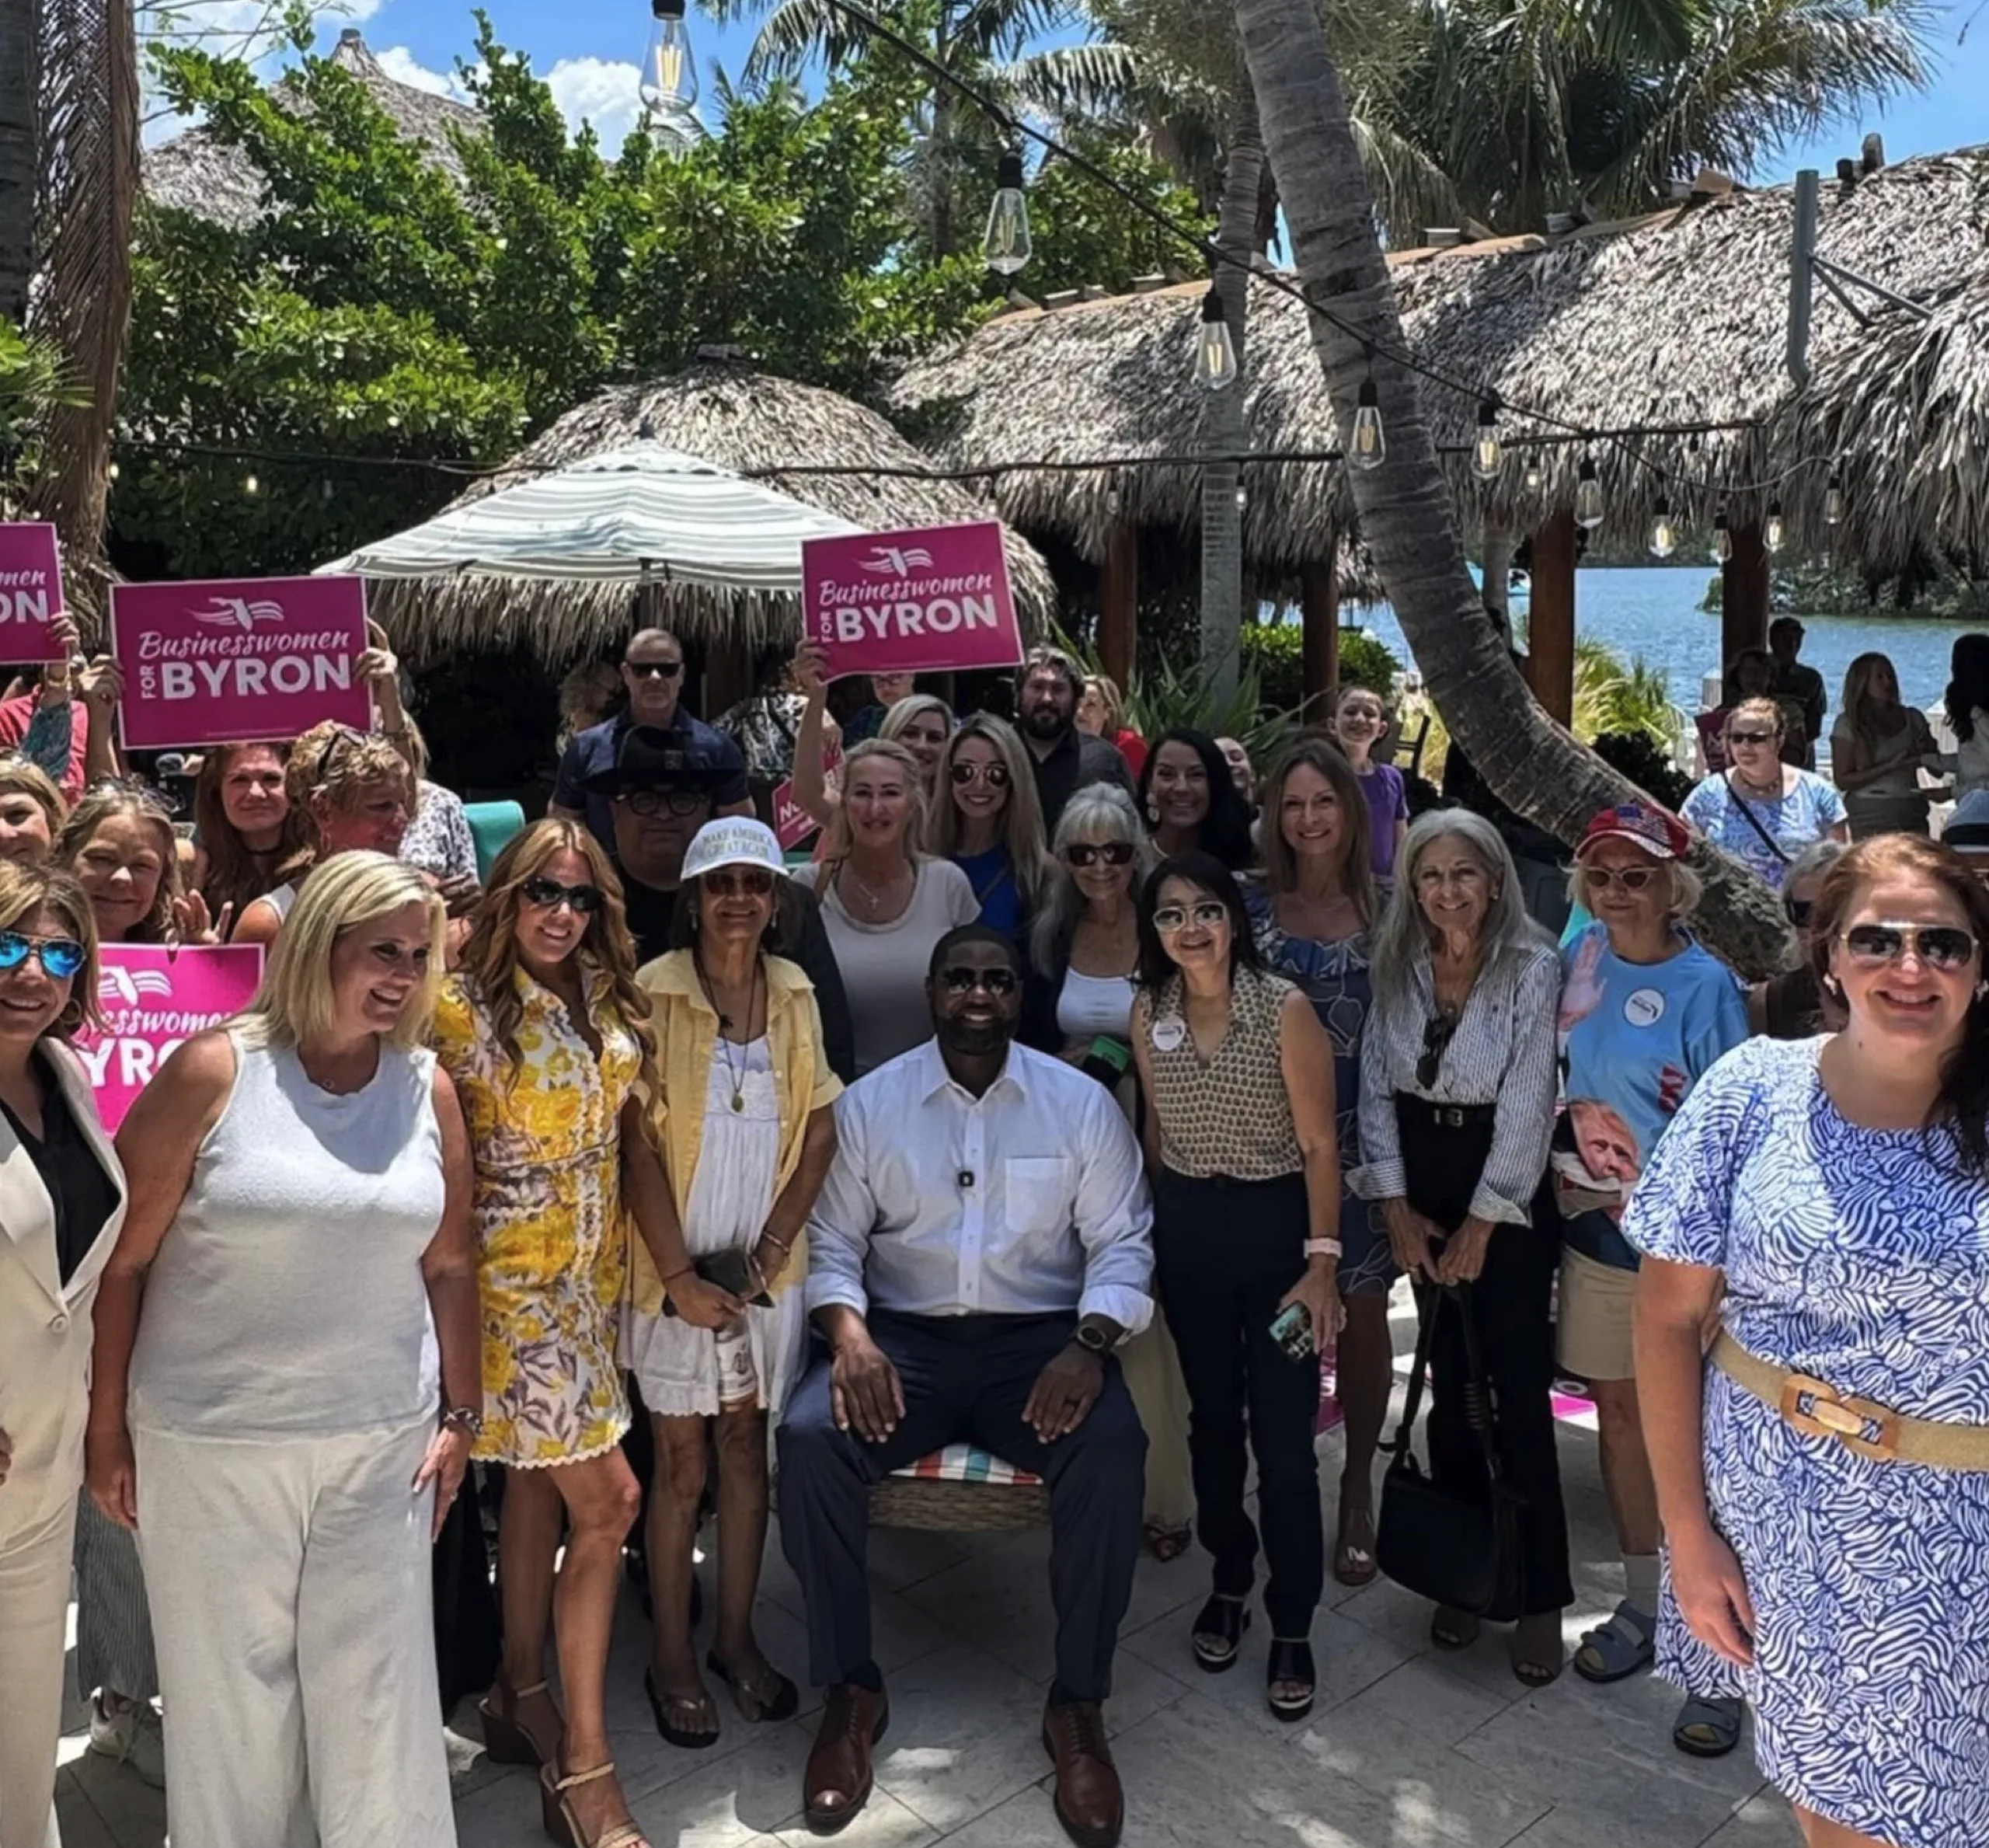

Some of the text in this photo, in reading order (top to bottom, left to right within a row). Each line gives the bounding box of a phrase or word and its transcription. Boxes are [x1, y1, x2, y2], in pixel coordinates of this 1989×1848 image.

[819, 573, 993, 606] Businesswomen
[820, 612, 834, 644] FOR
[835, 594, 998, 643] BYRON
[138, 630, 350, 660] Businesswomen
[140, 665, 156, 699] FOR
[161, 653, 351, 699] BYRON
[702, 829, 728, 845] MAKE
